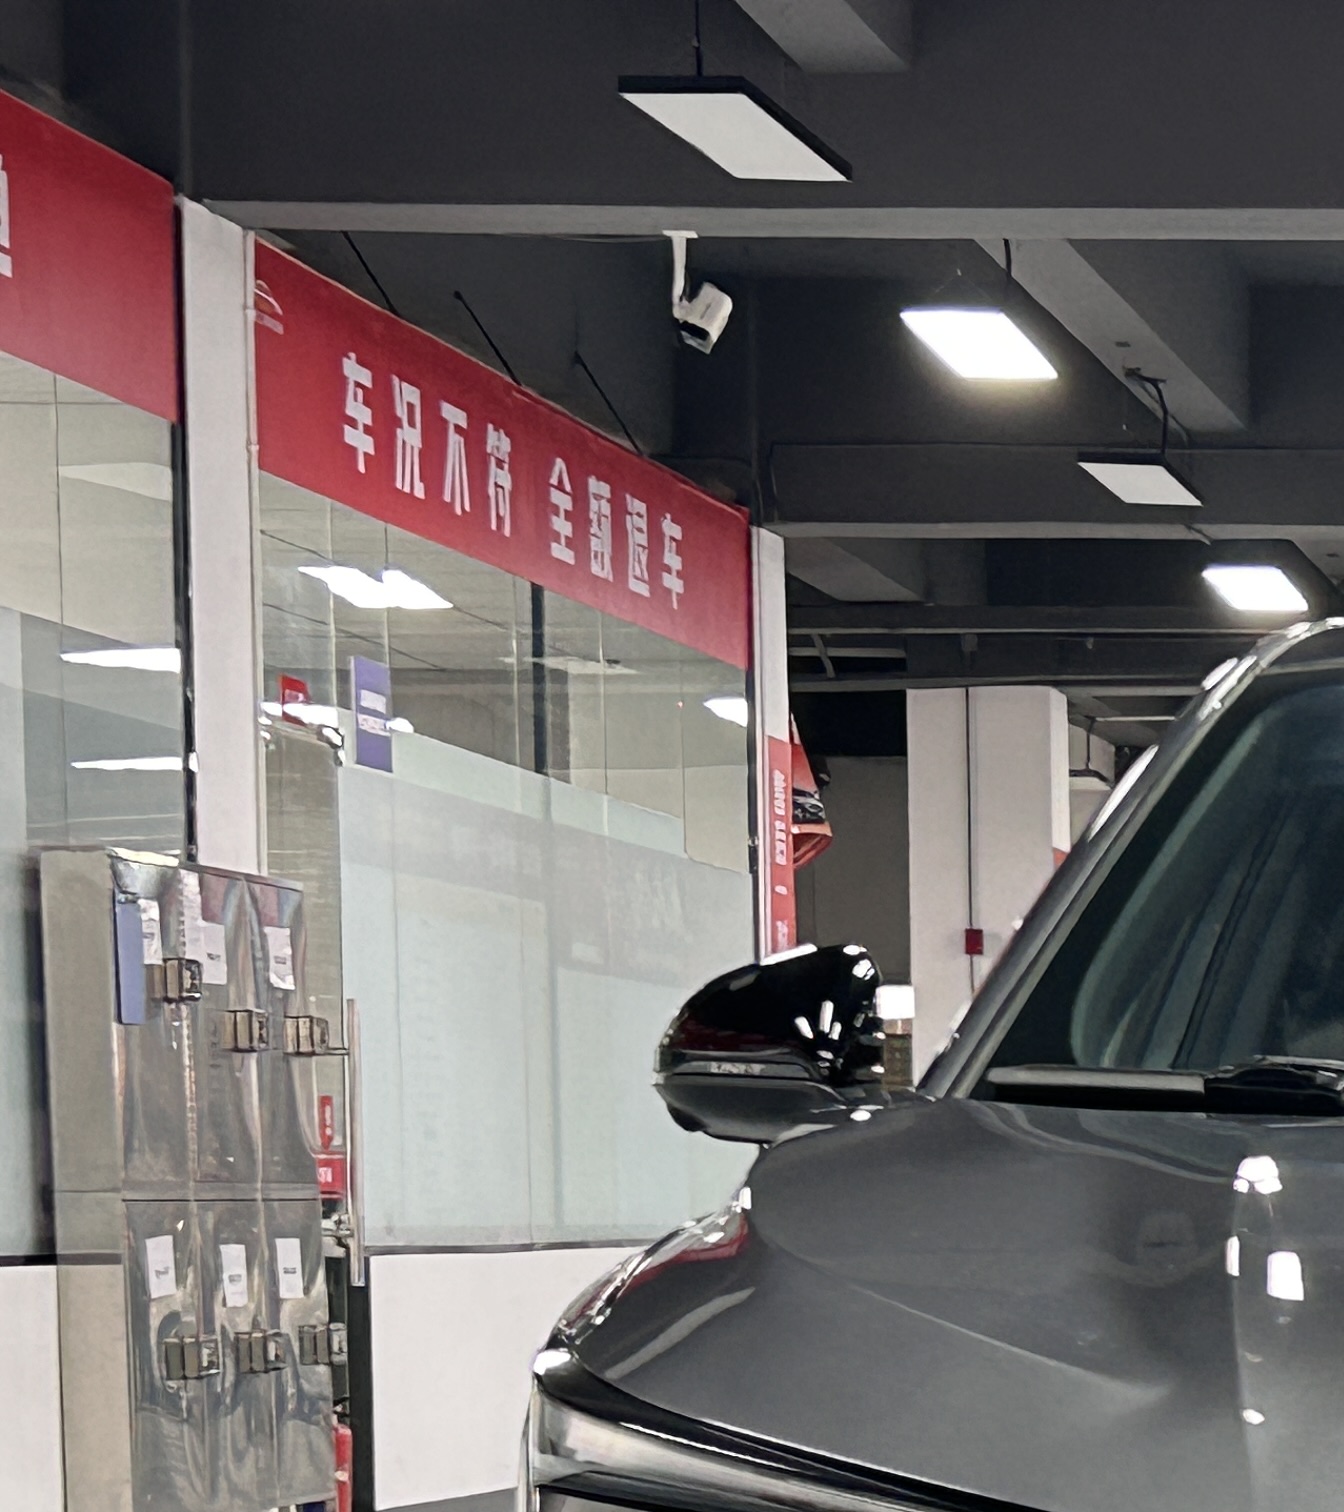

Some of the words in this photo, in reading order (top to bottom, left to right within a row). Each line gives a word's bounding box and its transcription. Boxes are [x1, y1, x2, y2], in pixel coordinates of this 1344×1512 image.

[342, 351, 513, 538] 车况不符
[549, 457, 685, 611] 全额退车
